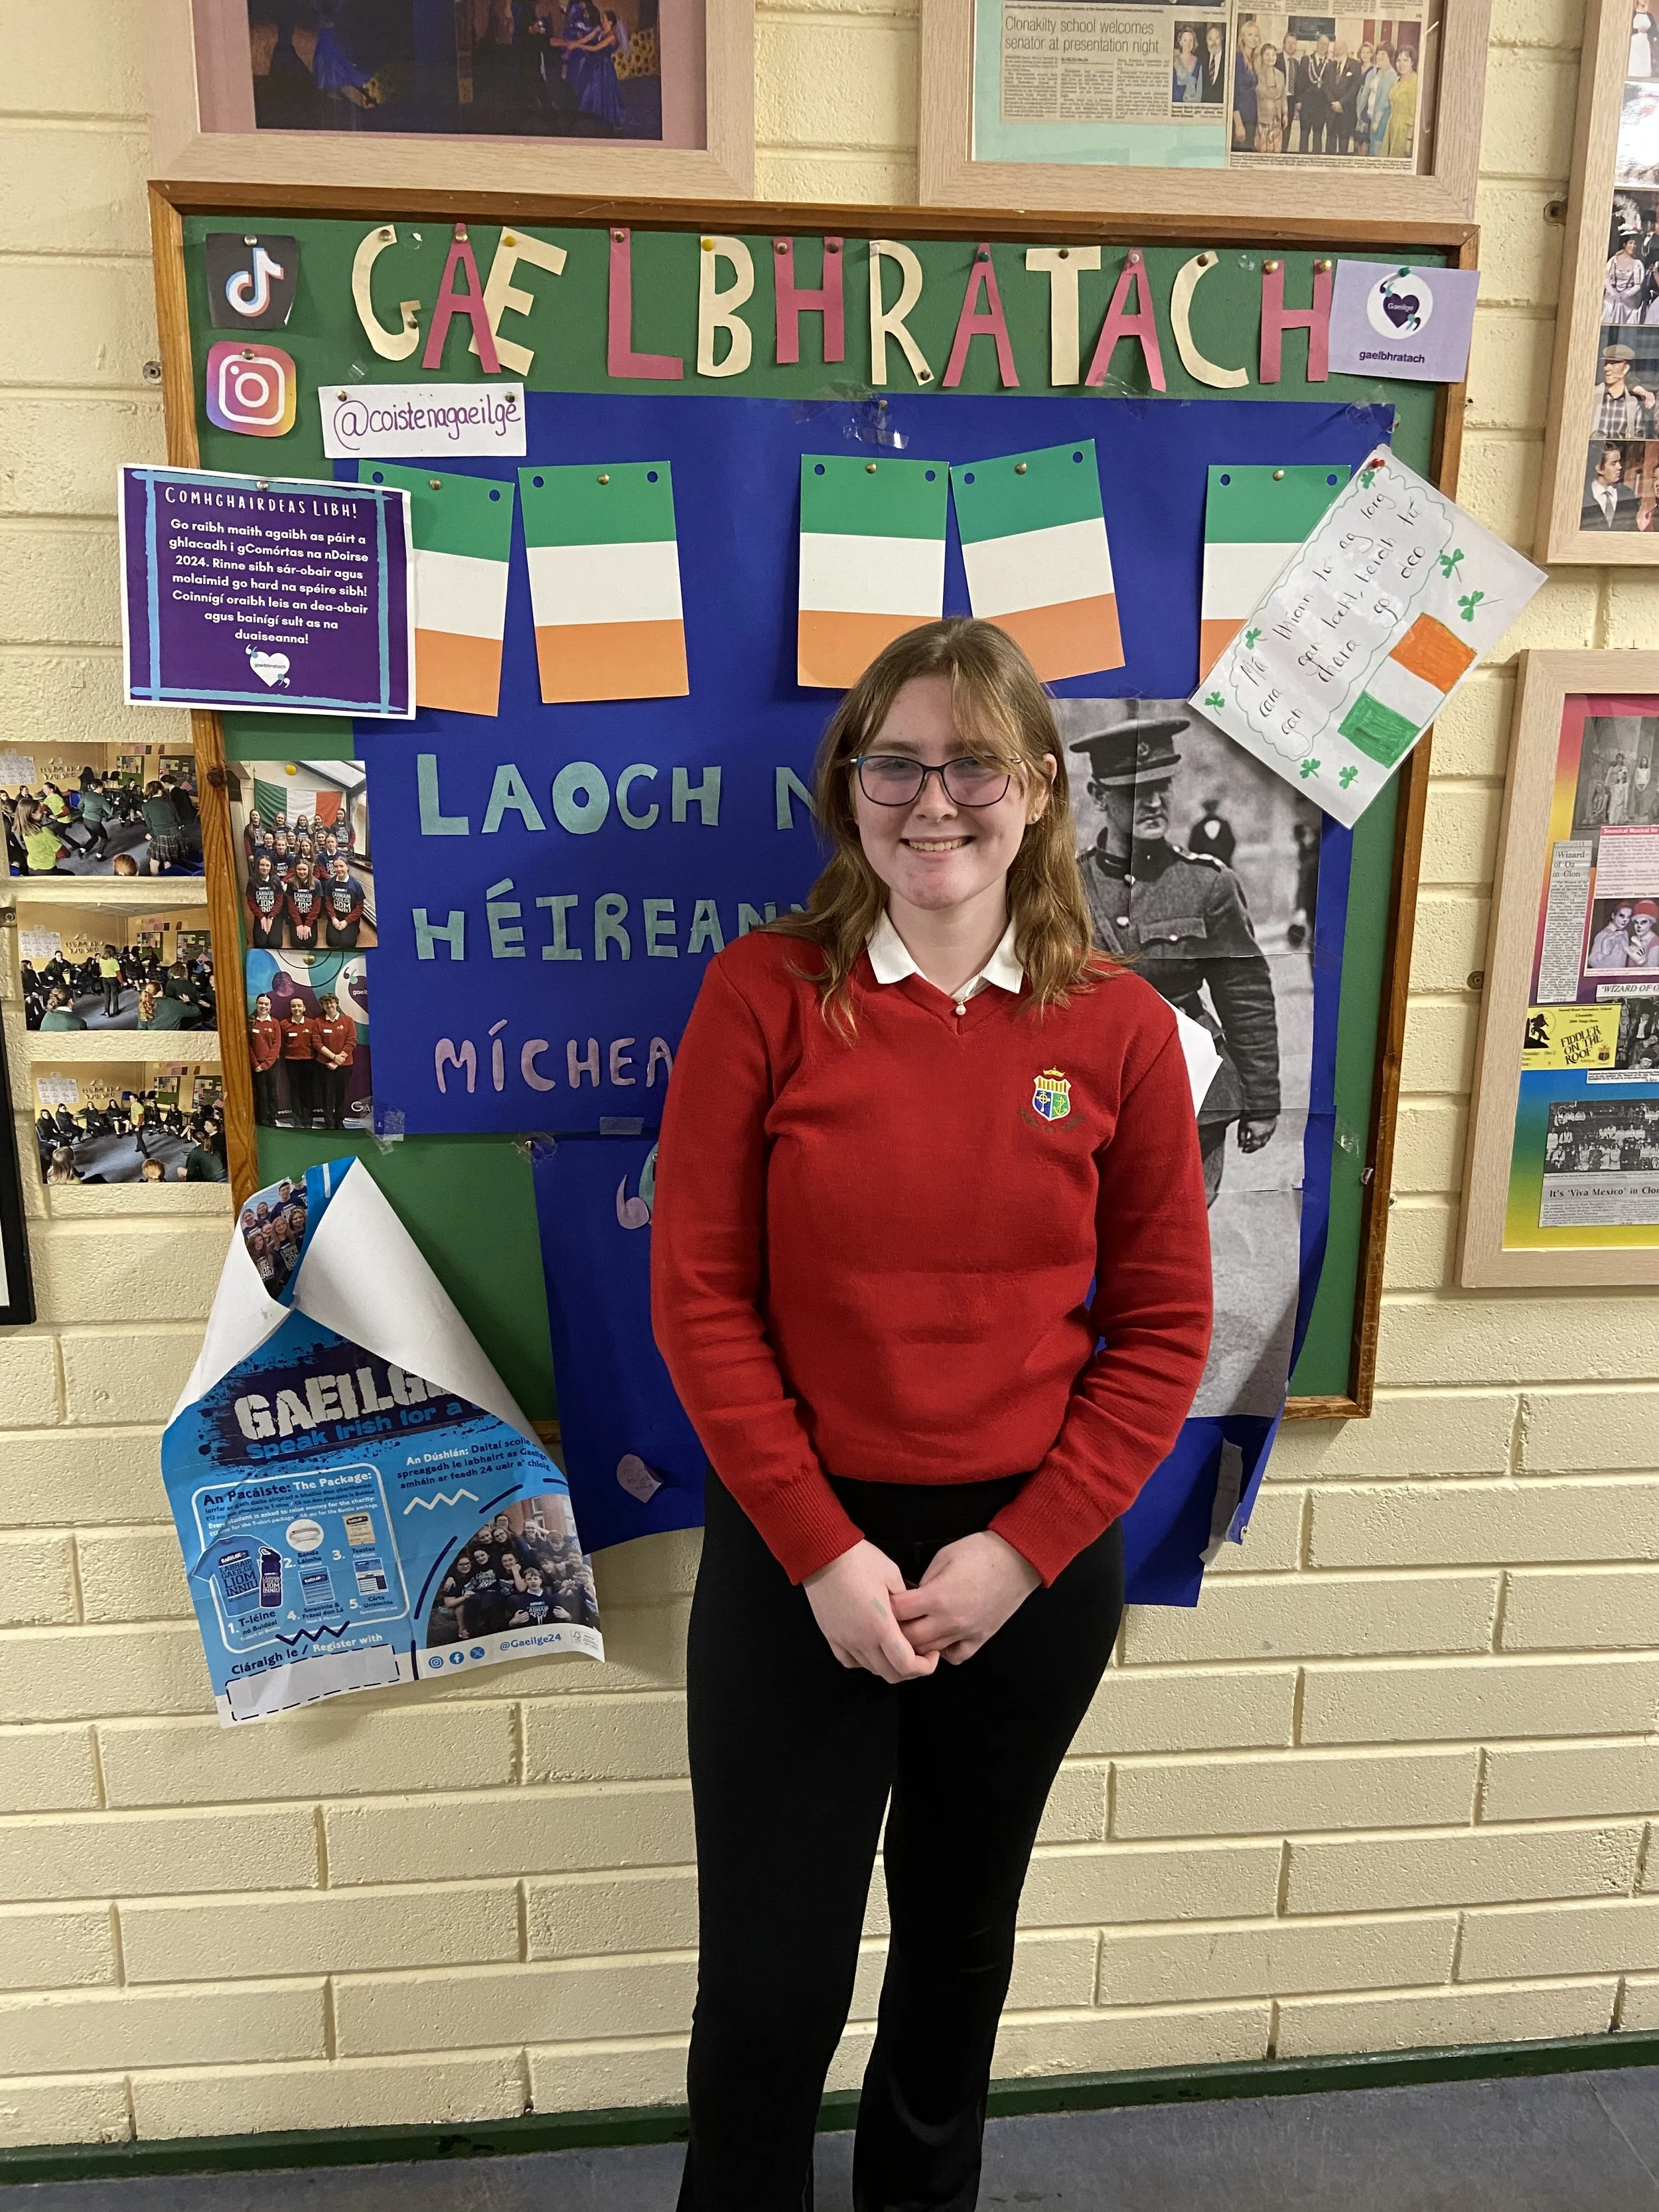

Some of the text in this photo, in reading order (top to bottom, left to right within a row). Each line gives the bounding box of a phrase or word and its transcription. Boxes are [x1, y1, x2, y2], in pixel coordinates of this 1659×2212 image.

[1005, 16, 1155, 35] Clonakilty school welcomes
[1005, 37, 1159, 56] senator at presentation night
[1387, 302, 1414, 312] Gaeilge
[1359, 350, 1425, 364] gaelbhratach
[333, 393, 522, 451] @coistenagaeilge
[165, 486, 358, 519] COMHGHAIRDEAS LIBH!
[171, 518, 366, 545] Go raibh maith agaibh as páirt a
[169, 537, 369, 562] ghlacadh i gComórtas na nDoirse
[175, 555, 364, 581] 2024. Rinne sibh sár-obair agus
[173, 573, 368, 597] molaimid go hard na spéire sibh!
[1240, 658, 1269, 687] Má
[1339, 532, 1374, 553] ag
[1360, 493, 1397, 520] lorg
[172, 589, 368, 615] Coinnígí oraibh leis an dea-obair
[204, 611, 338, 630] agus bainígí sult as na
[1317, 638, 1362, 684] chara
[1372, 597, 1399, 629] go
[1400, 546, 1425, 580] deo
[234, 630, 309, 644] duaiseanna!
[1259, 688, 1283, 719] cara
[1298, 641, 1321, 678] gan
[1355, 536, 1397, 584] beidh
[416, 753, 722, 836] LAOCH
[411, 877, 807, 962] HÉIREAN
[1561, 1025, 1602, 1048] FIDDLER
[1564, 1034, 1603, 1055] ON THE
[1565, 1046, 1593, 1065] ROOF
[335, 1415, 393, 1440] Irish
[399, 1405, 438, 1427] for
[447, 1400, 463, 1416] a
[397, 1463, 450, 1480] spreagadh
[452, 1460, 463, 1469] le
[464, 1452, 505, 1467] labhairt
[520, 1447, 548, 1461] Gaeilge
[406, 1456, 421, 1466] An
[423, 1448, 469, 1463] Dúshlán:
[471, 1440, 502, 1454] Daltaí
[400, 1475, 435, 1489] amháin
[438, 1474, 448, 1483] ar
[451, 1469, 478, 1481] feadh
[480, 1465, 493, 1475] 24
[495, 1461, 514, 1471] uair
[528, 1460, 551, 1472] chloig
[203, 1494, 224, 1507] An
[227, 1483, 292, 1503] Pacáiste:
[292, 1480, 317, 1491] The
[319, 1471, 372, 1488] Package:
[228, 1514, 253, 1525] student
[219, 1558, 252, 1573] LABHAIR
[283, 1558, 296, 1569] 2.
[297, 1550, 319, 1558] Banda
[332, 1550, 346, 1560] 3.
[221, 1564, 253, 1579] GAEILGE
[224, 1570, 257, 1588] LIOM
[226, 1580, 259, 1597] INNIU
[287, 1610, 301, 1620] 4.
[349, 1598, 362, 1609] 5.
[228, 1622, 240, 1634] 1.
[238, 1609, 276, 1627] T-léine
[252, 1619, 277, 1632] Buidéal
[231, 1651, 283, 1674] Cláraigh
[286, 1648, 299, 1659] le
[312, 1639, 356, 1653] Register
[359, 1633, 384, 1645] with
[499, 1633, 561, 1651] @Gaeilge24
